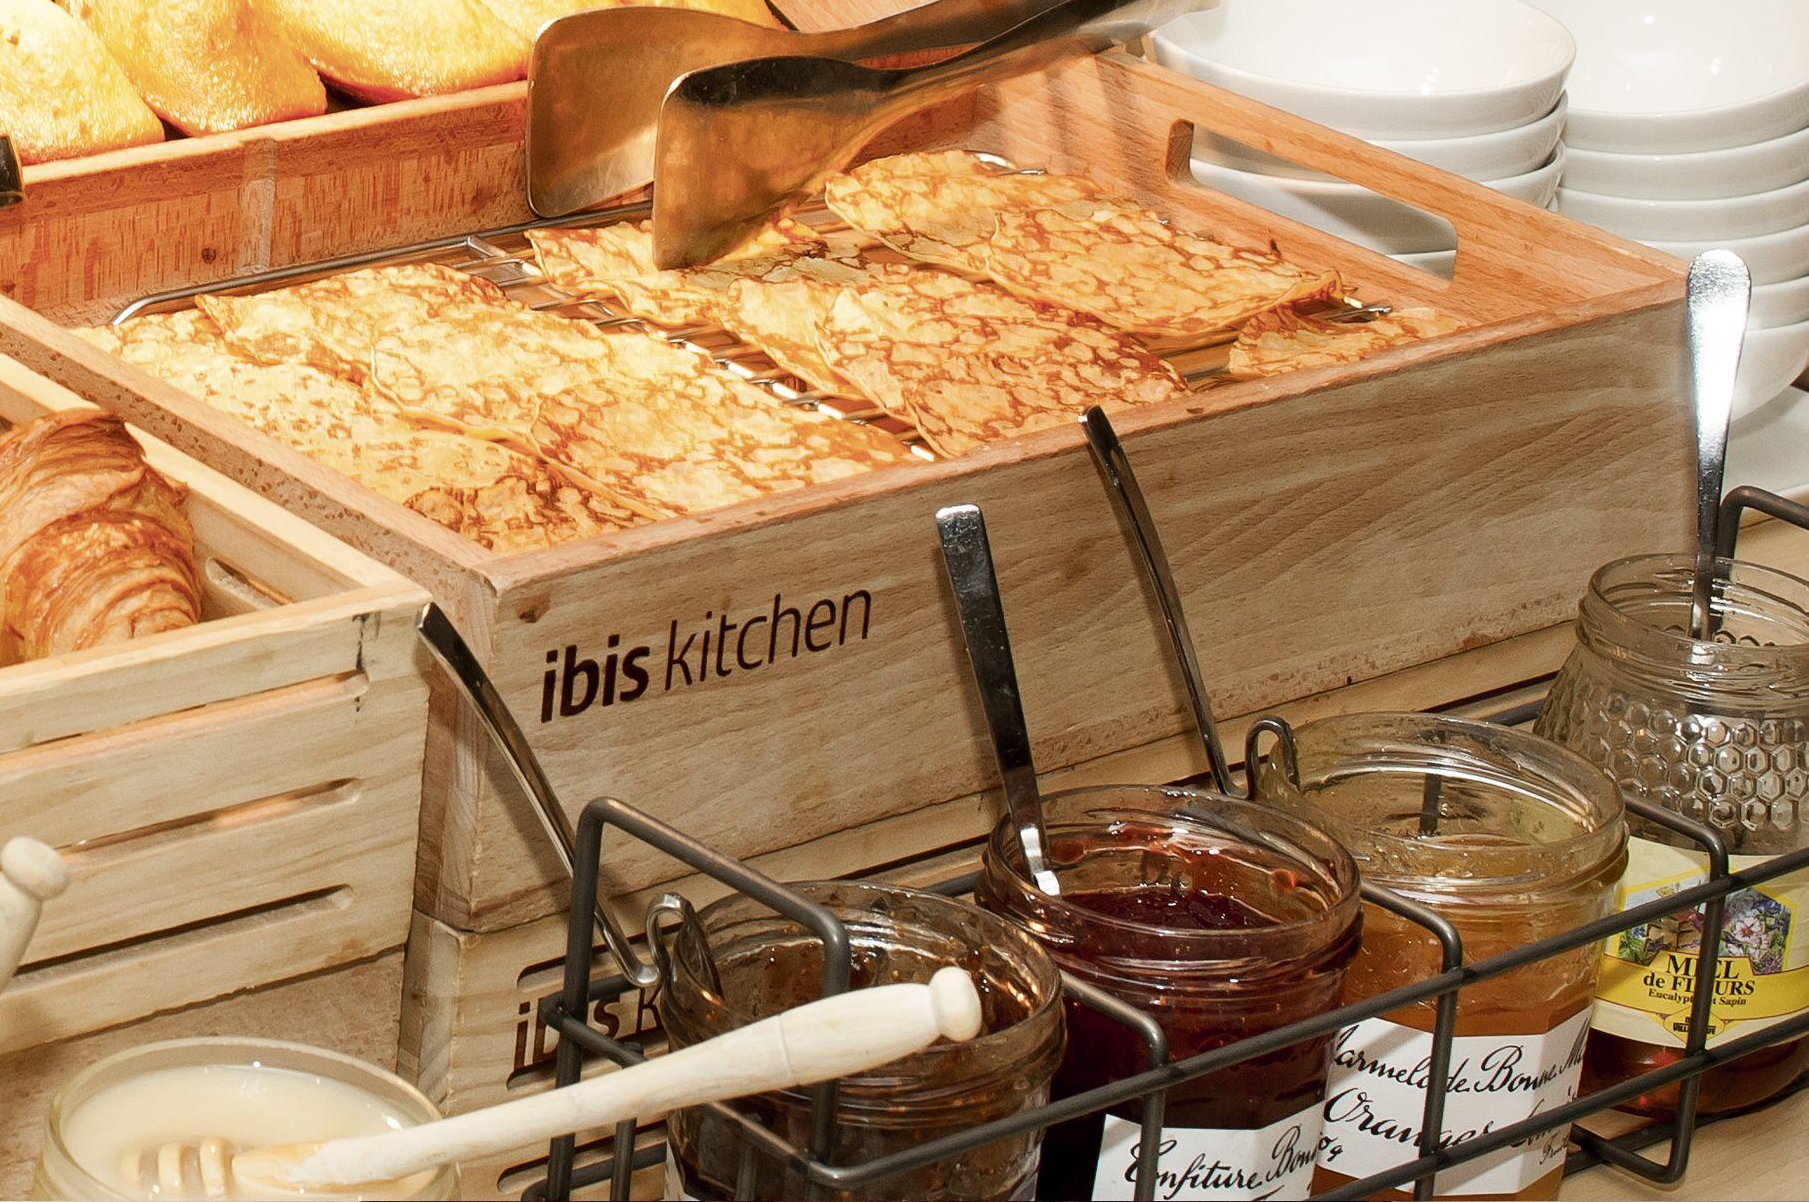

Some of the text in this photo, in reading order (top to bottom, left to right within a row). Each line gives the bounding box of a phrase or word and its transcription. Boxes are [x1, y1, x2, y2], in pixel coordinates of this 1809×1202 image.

[540, 589, 873, 724] ibis kitchen
[1643, 972, 1756, 996] de FLURS
[1666, 954, 1739, 979] ML
[1718, 997, 1748, 1008] Sapin
[513, 993, 621, 1070] ibs
[1124, 1139, 1263, 1200] Cnfiture
